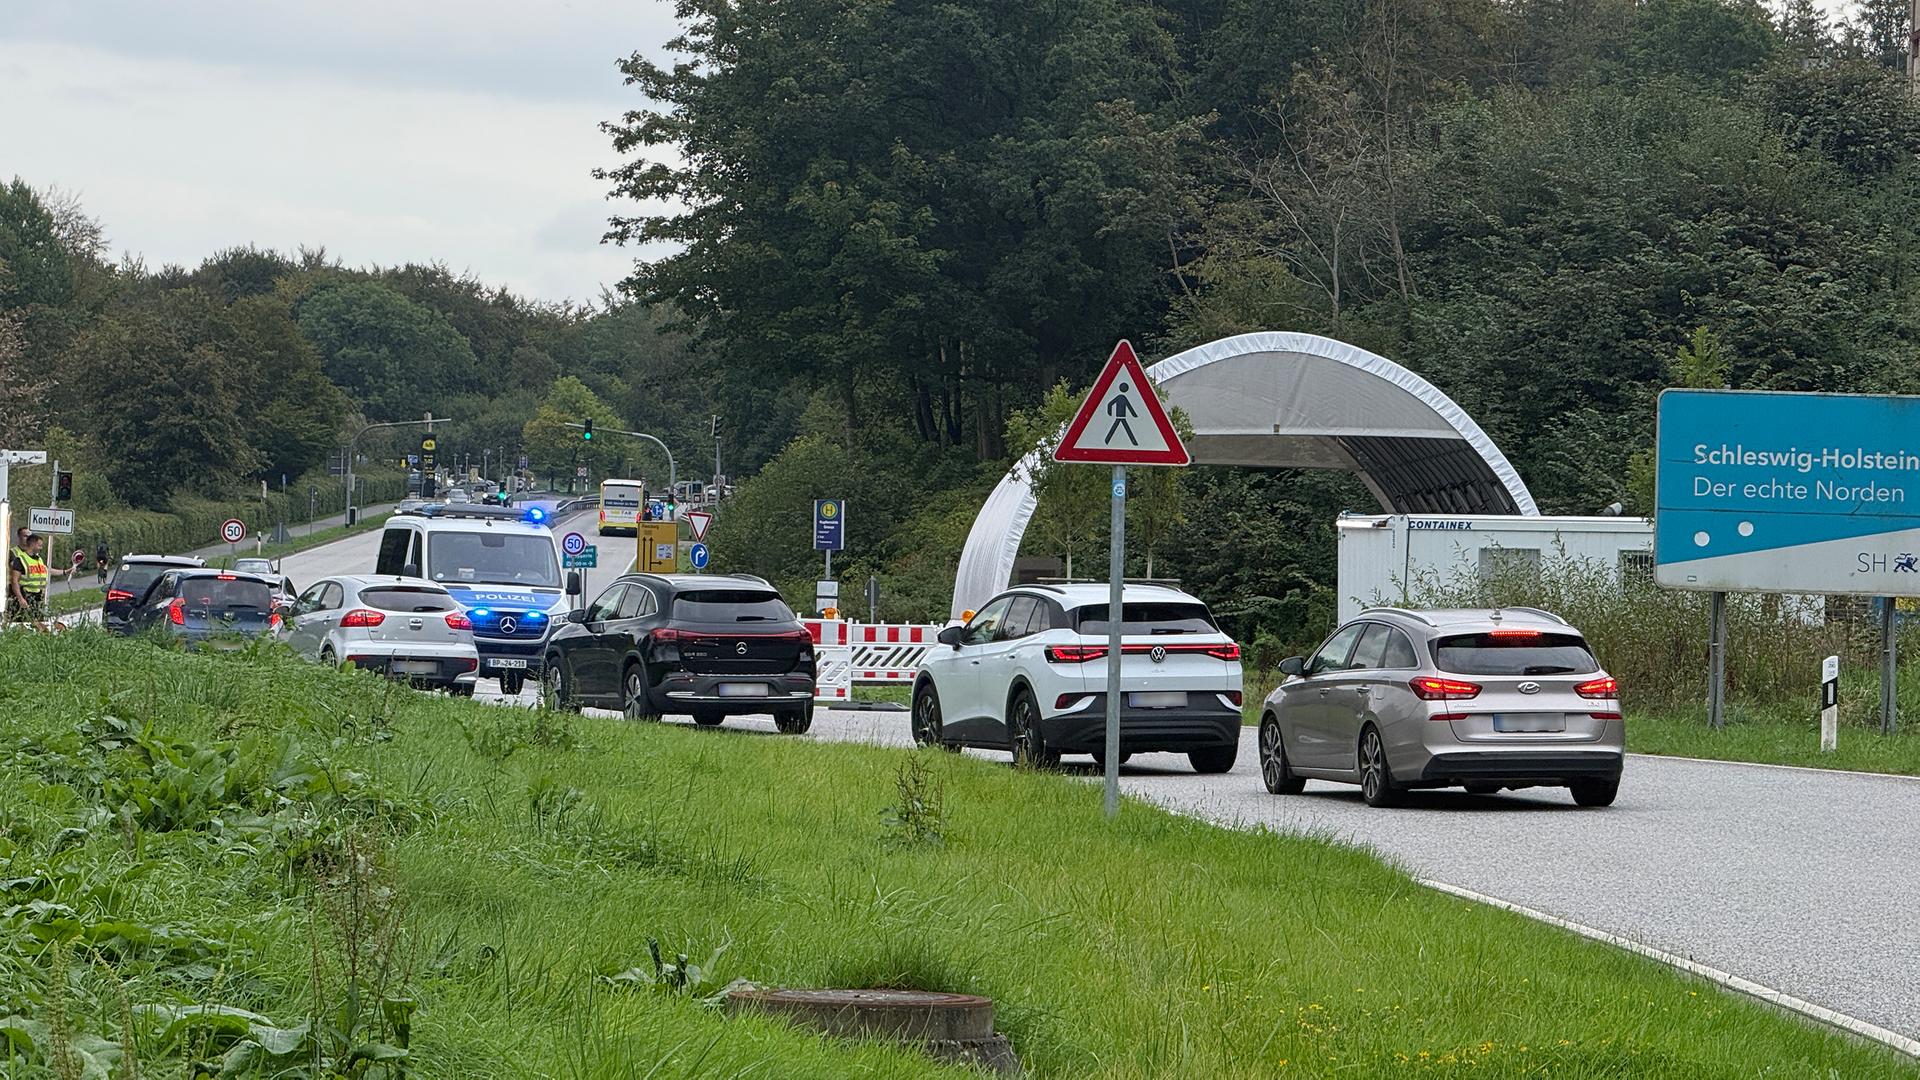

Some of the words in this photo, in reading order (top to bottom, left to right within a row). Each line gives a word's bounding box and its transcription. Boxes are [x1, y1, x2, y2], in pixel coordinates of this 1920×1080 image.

[1693, 444, 1920, 474] Schleswig-Holstein
[1693, 476, 1737, 498] Der
[1743, 478, 1808, 500] echte
[1815, 480, 1905, 504] Norden
[33, 514, 71, 527] Kontrolle
[1408, 521, 1473, 530] CONTAINEX
[226, 525, 242, 539] 50
[566, 538, 581, 551] 50
[1857, 552, 1887, 574] SH
[475, 594, 537, 603] POLIZEI
